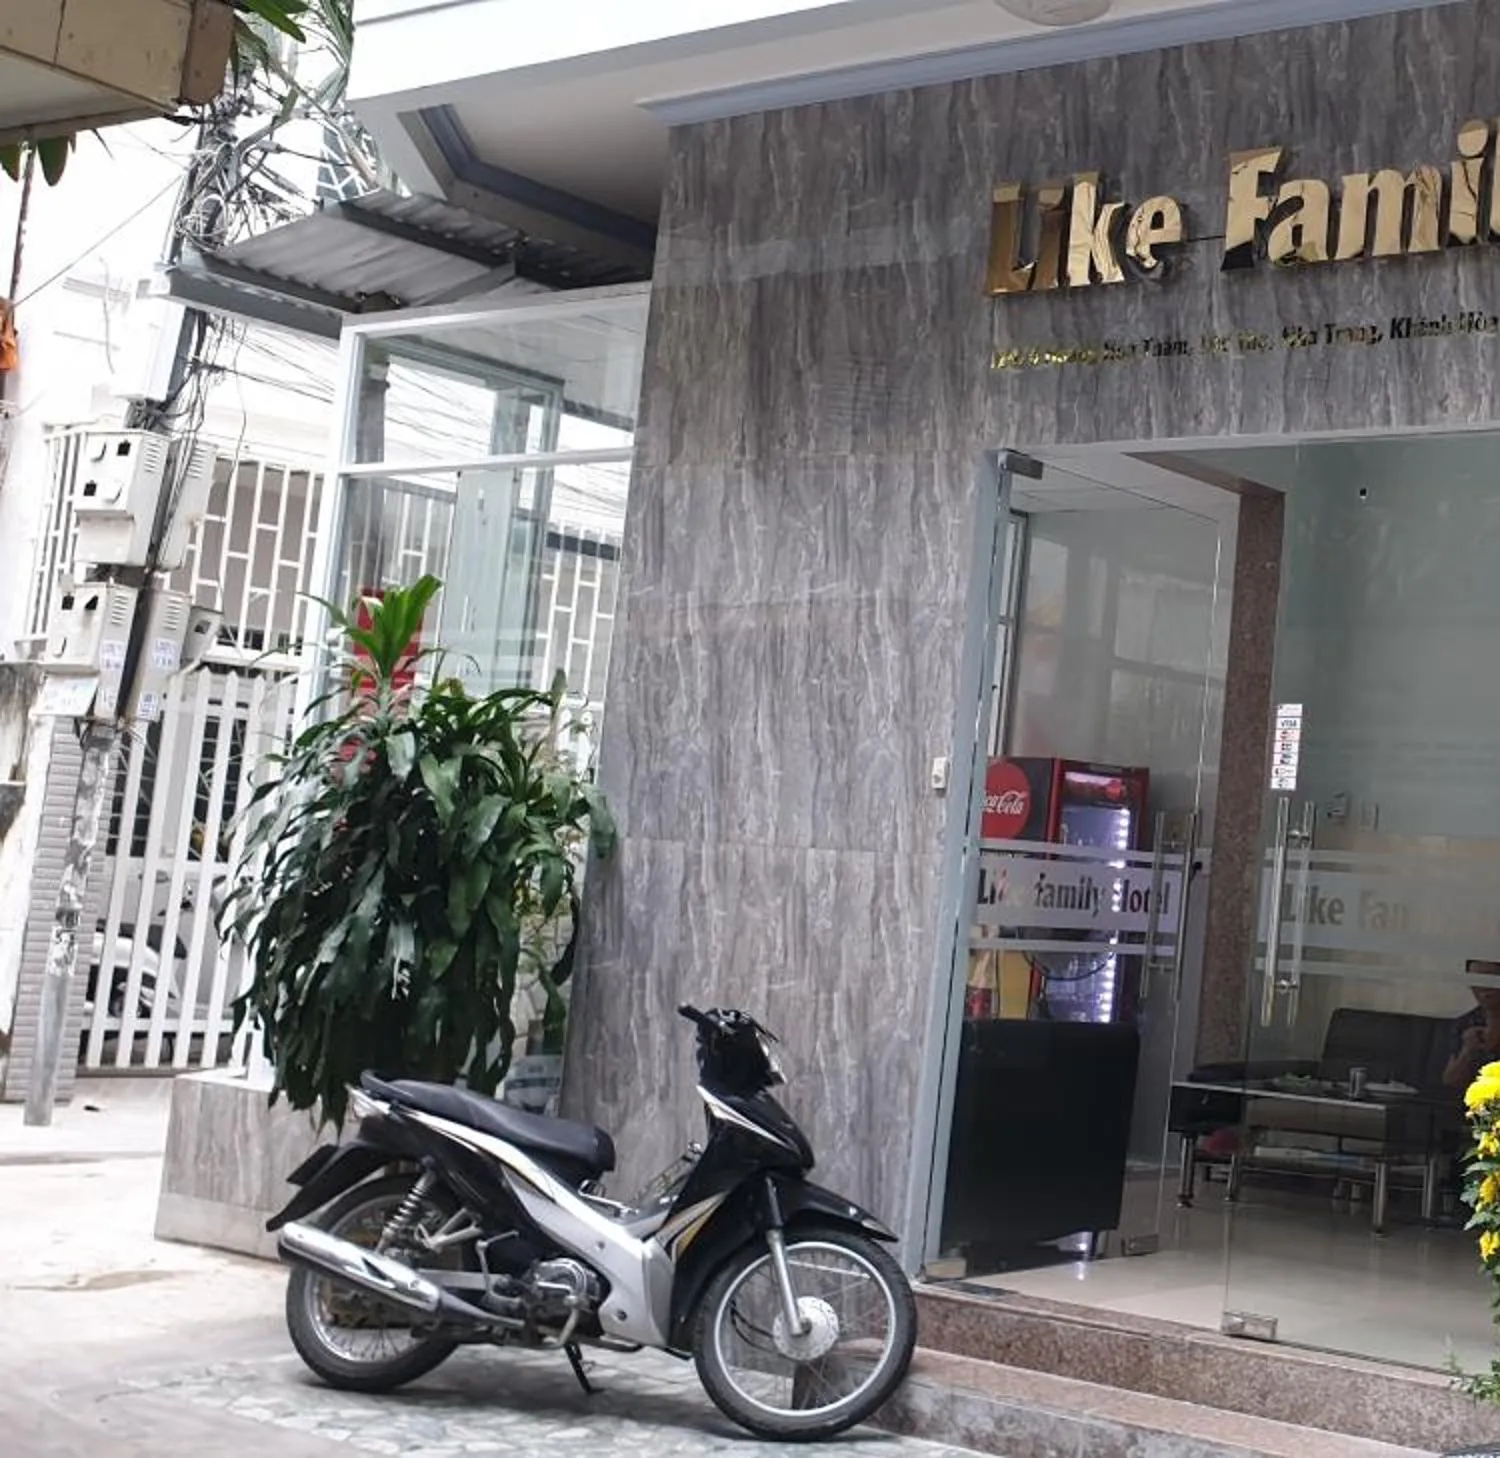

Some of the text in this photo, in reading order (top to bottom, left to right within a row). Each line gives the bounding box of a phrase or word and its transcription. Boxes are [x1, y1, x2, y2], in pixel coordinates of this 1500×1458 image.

[986, 171, 1184, 296] Like
[1112, 879, 1170, 914] otl
[1282, 883, 1345, 925] Lke
